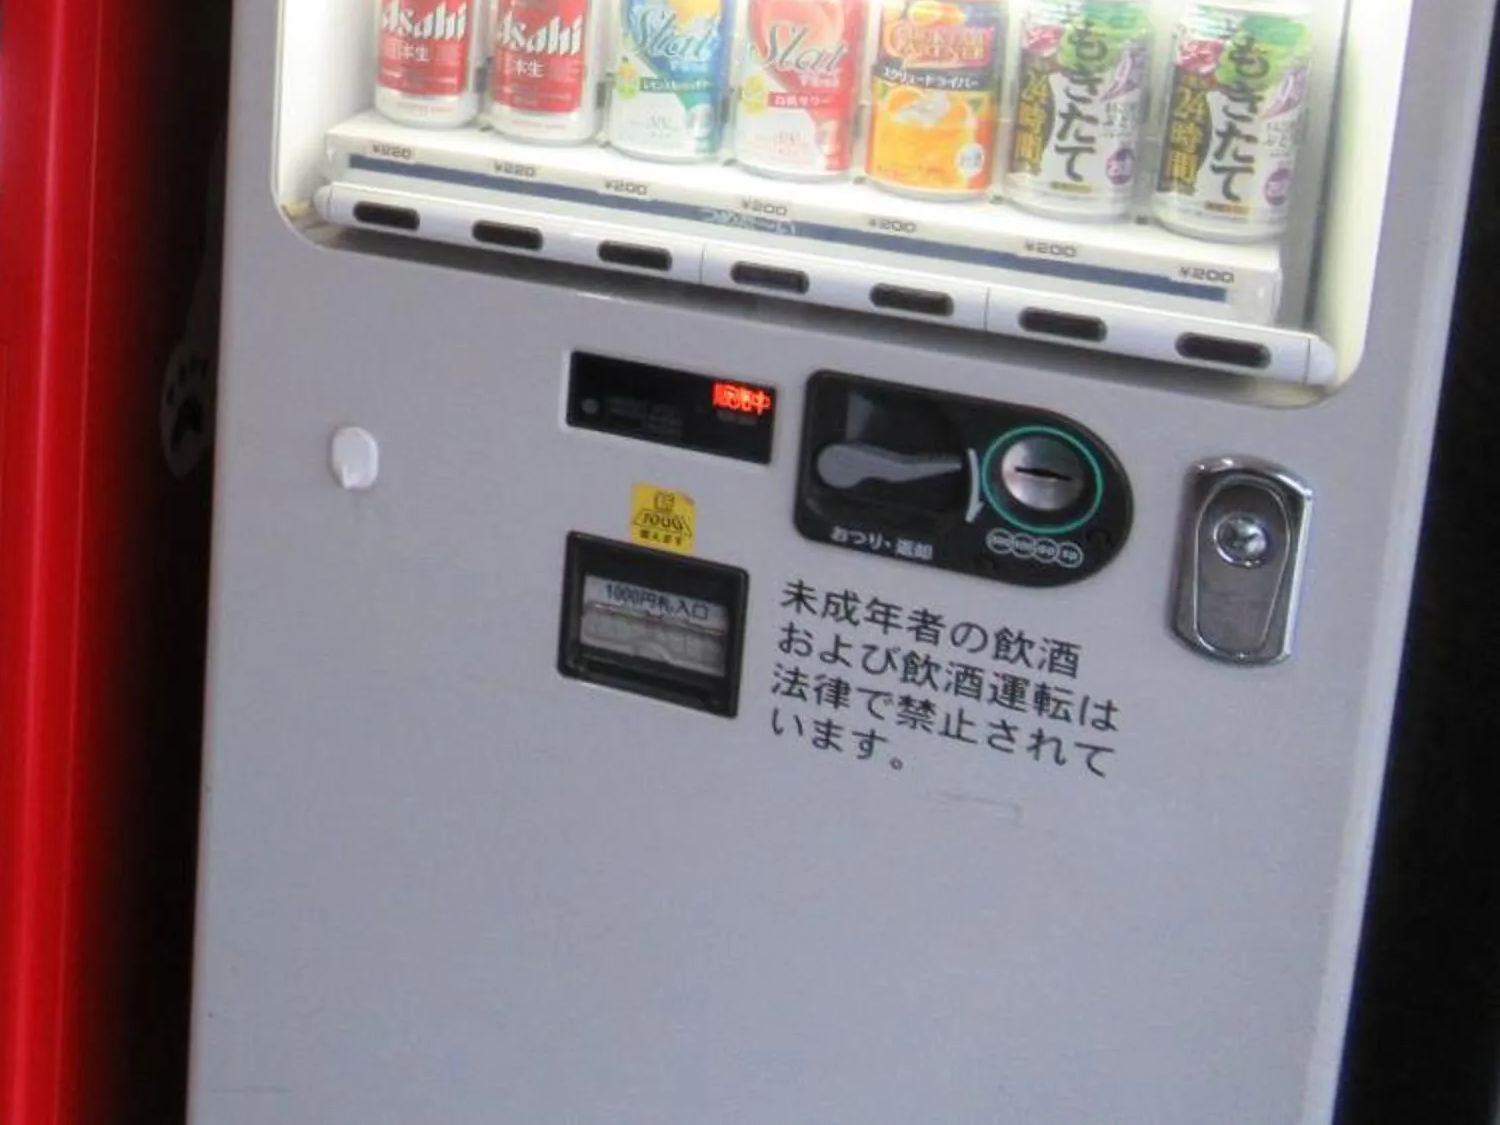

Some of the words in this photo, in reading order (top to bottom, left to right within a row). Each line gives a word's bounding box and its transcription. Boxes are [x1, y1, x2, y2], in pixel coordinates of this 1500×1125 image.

[497, 9, 583, 57] Asahi
[513, 58, 546, 79] 本生
[372, 144, 413, 160] ¥220
[493, 160, 537, 178] ¥220
[603, 176, 649, 196] ¥200
[740, 197, 790, 217] ¥200
[1024, 240, 1078, 259] ¥200
[1178, 263, 1236, 284] ¥200
[604, 581, 711, 623] 1000円札入口
[780, 578, 1083, 680] 未成年者の飲酒
[778, 623, 1121, 734] および飲酒運転は
[771, 667, 1118, 780] 法律で禁止されて
[770, 708, 905, 774] います。
